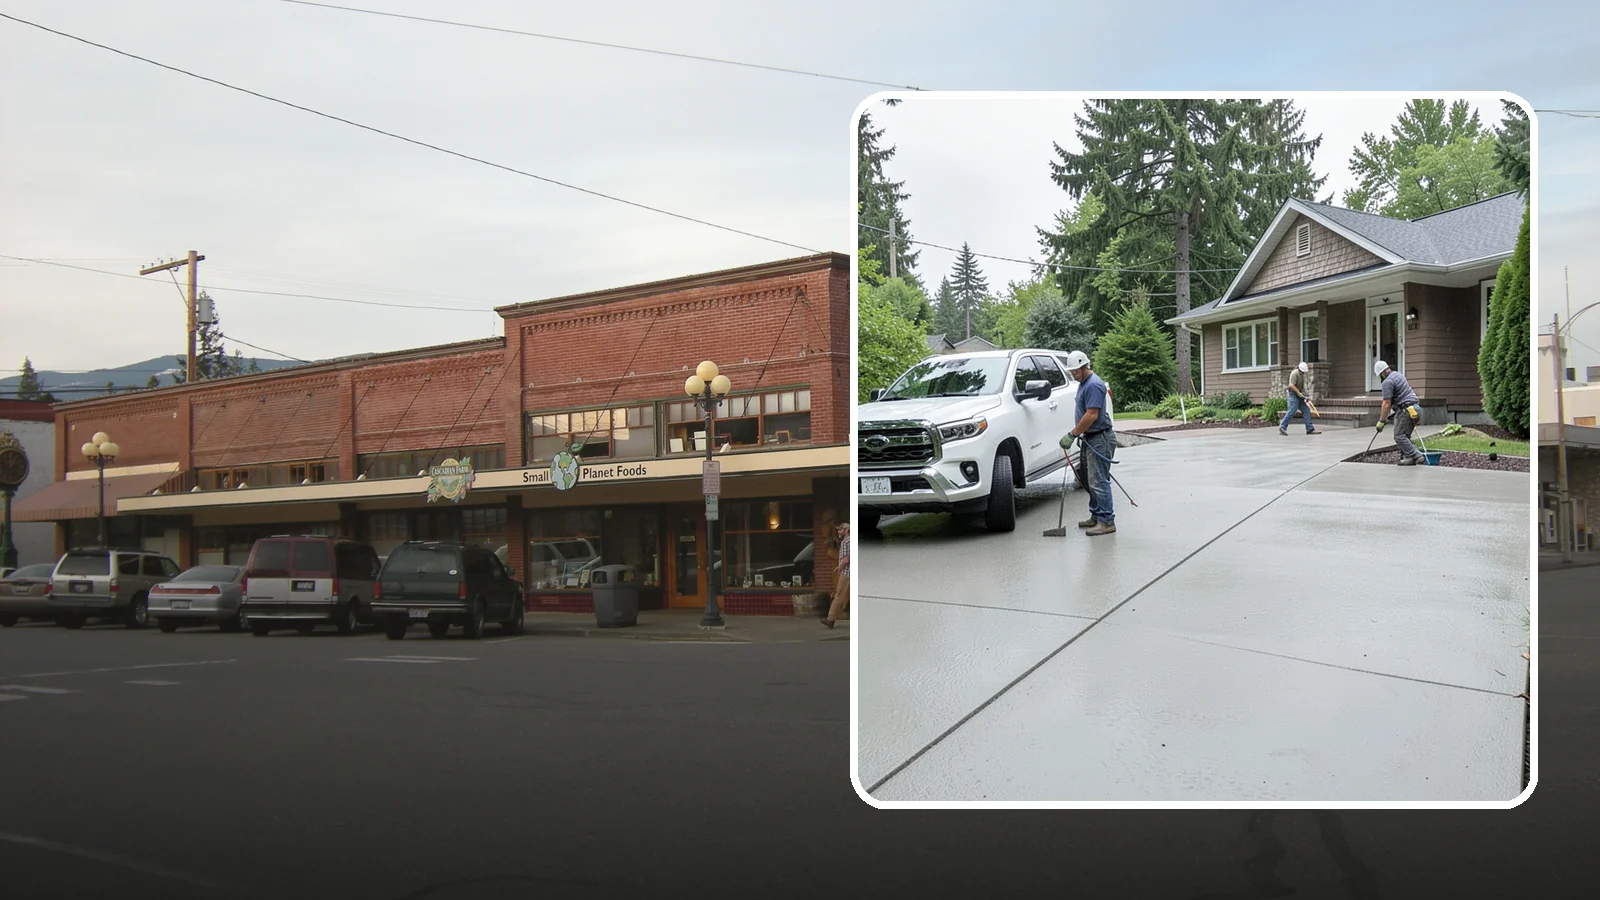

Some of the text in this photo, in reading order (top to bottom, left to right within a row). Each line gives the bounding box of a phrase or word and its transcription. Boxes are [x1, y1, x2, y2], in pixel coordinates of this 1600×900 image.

[523, 464, 647, 483] Small Planet Foods
